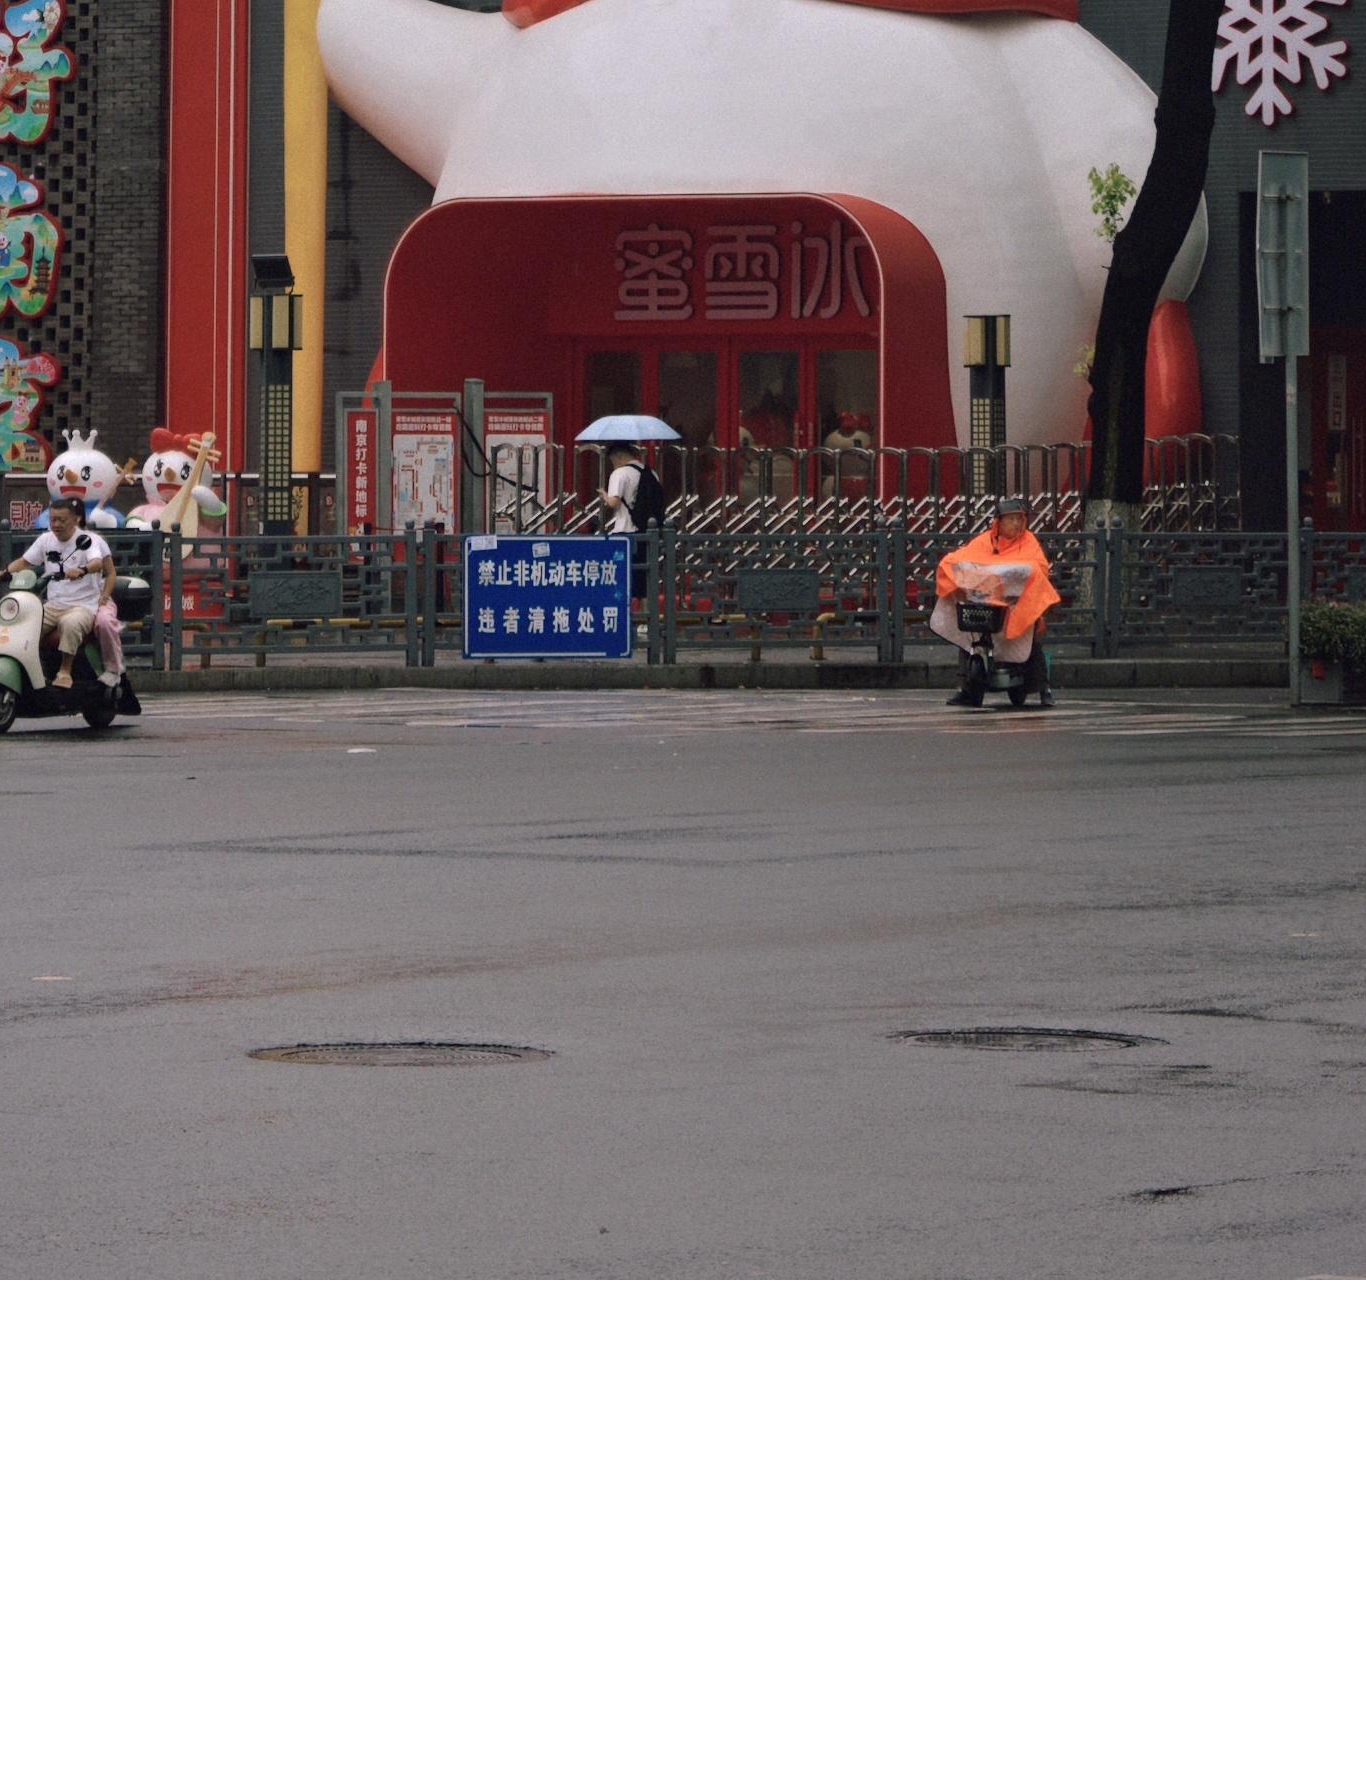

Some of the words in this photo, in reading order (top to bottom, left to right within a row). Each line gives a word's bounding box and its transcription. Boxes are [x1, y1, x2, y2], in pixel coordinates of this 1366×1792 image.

[613, 220, 872, 321] 蜜雪冰
[355, 419, 368, 518] 南京打卡新地标
[478, 559, 618, 587] 禁止非机动车停放
[478, 606, 619, 634] 违者清拖处罚
